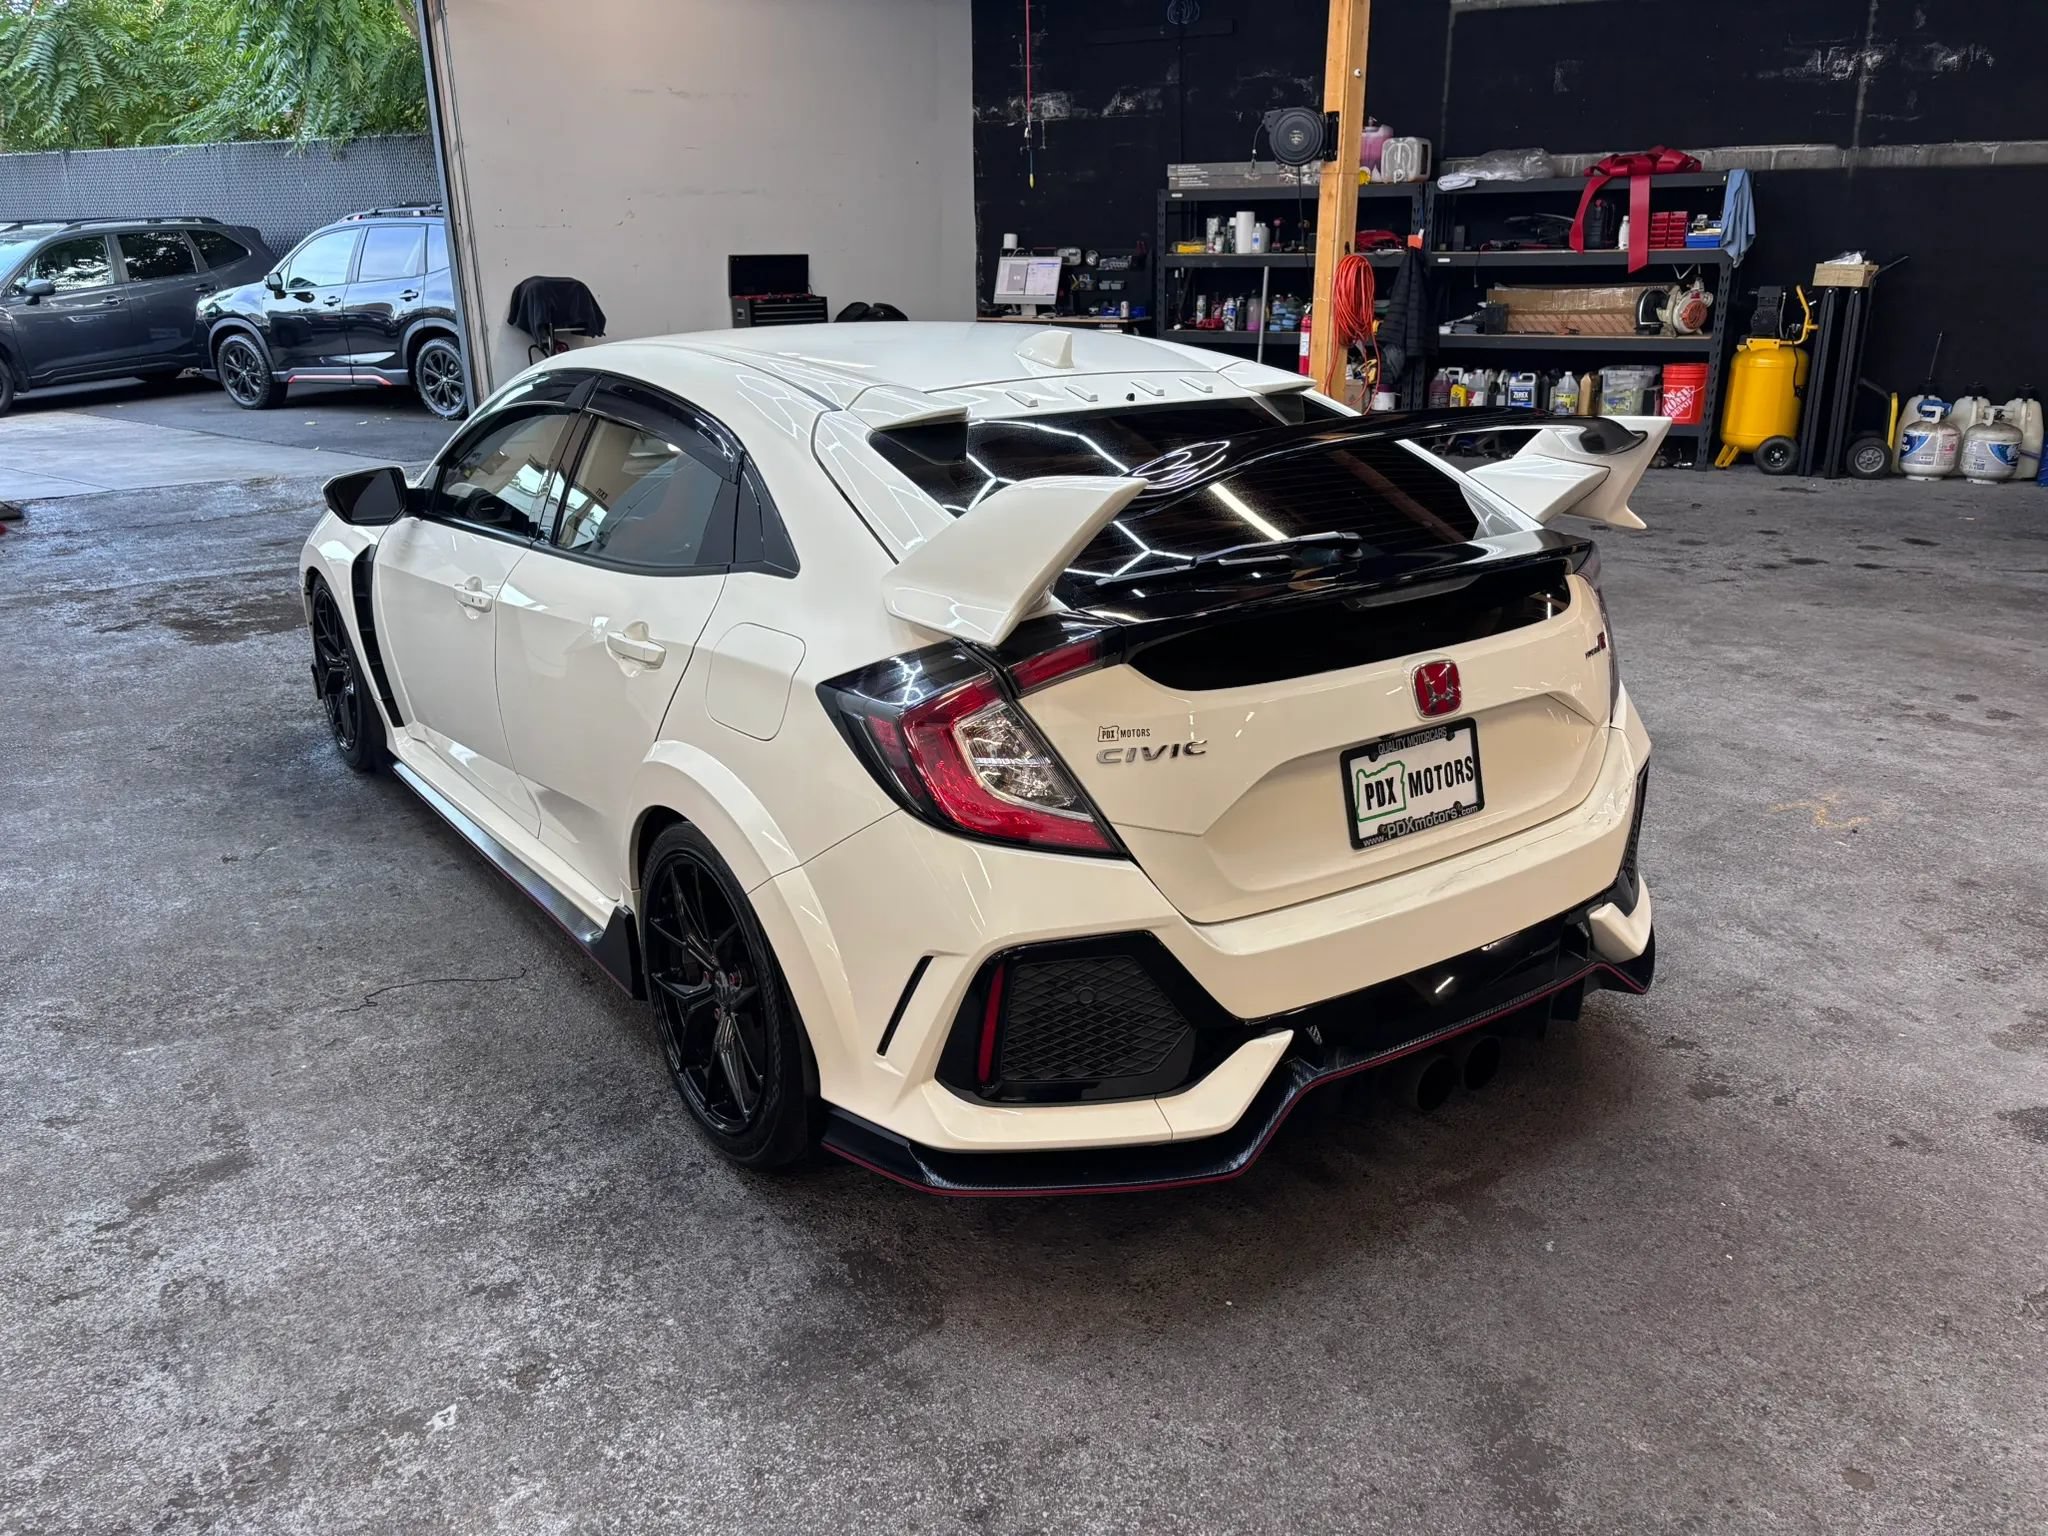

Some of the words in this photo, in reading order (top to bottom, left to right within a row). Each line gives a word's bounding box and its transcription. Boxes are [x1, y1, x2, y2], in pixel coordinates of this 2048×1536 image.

[1102, 730, 1115, 739] PDX
[1120, 728, 1151, 738] MOTORS
[1377, 737, 1406, 755] QUALITY
[1406, 727, 1447, 747] MOTORCARS
[1096, 740, 1208, 764] CIVIC
[1364, 776, 1398, 811] PDX
[1407, 756, 1474, 798] MOTORS
[1362, 806, 1478, 846] www.PDXmotors.com
